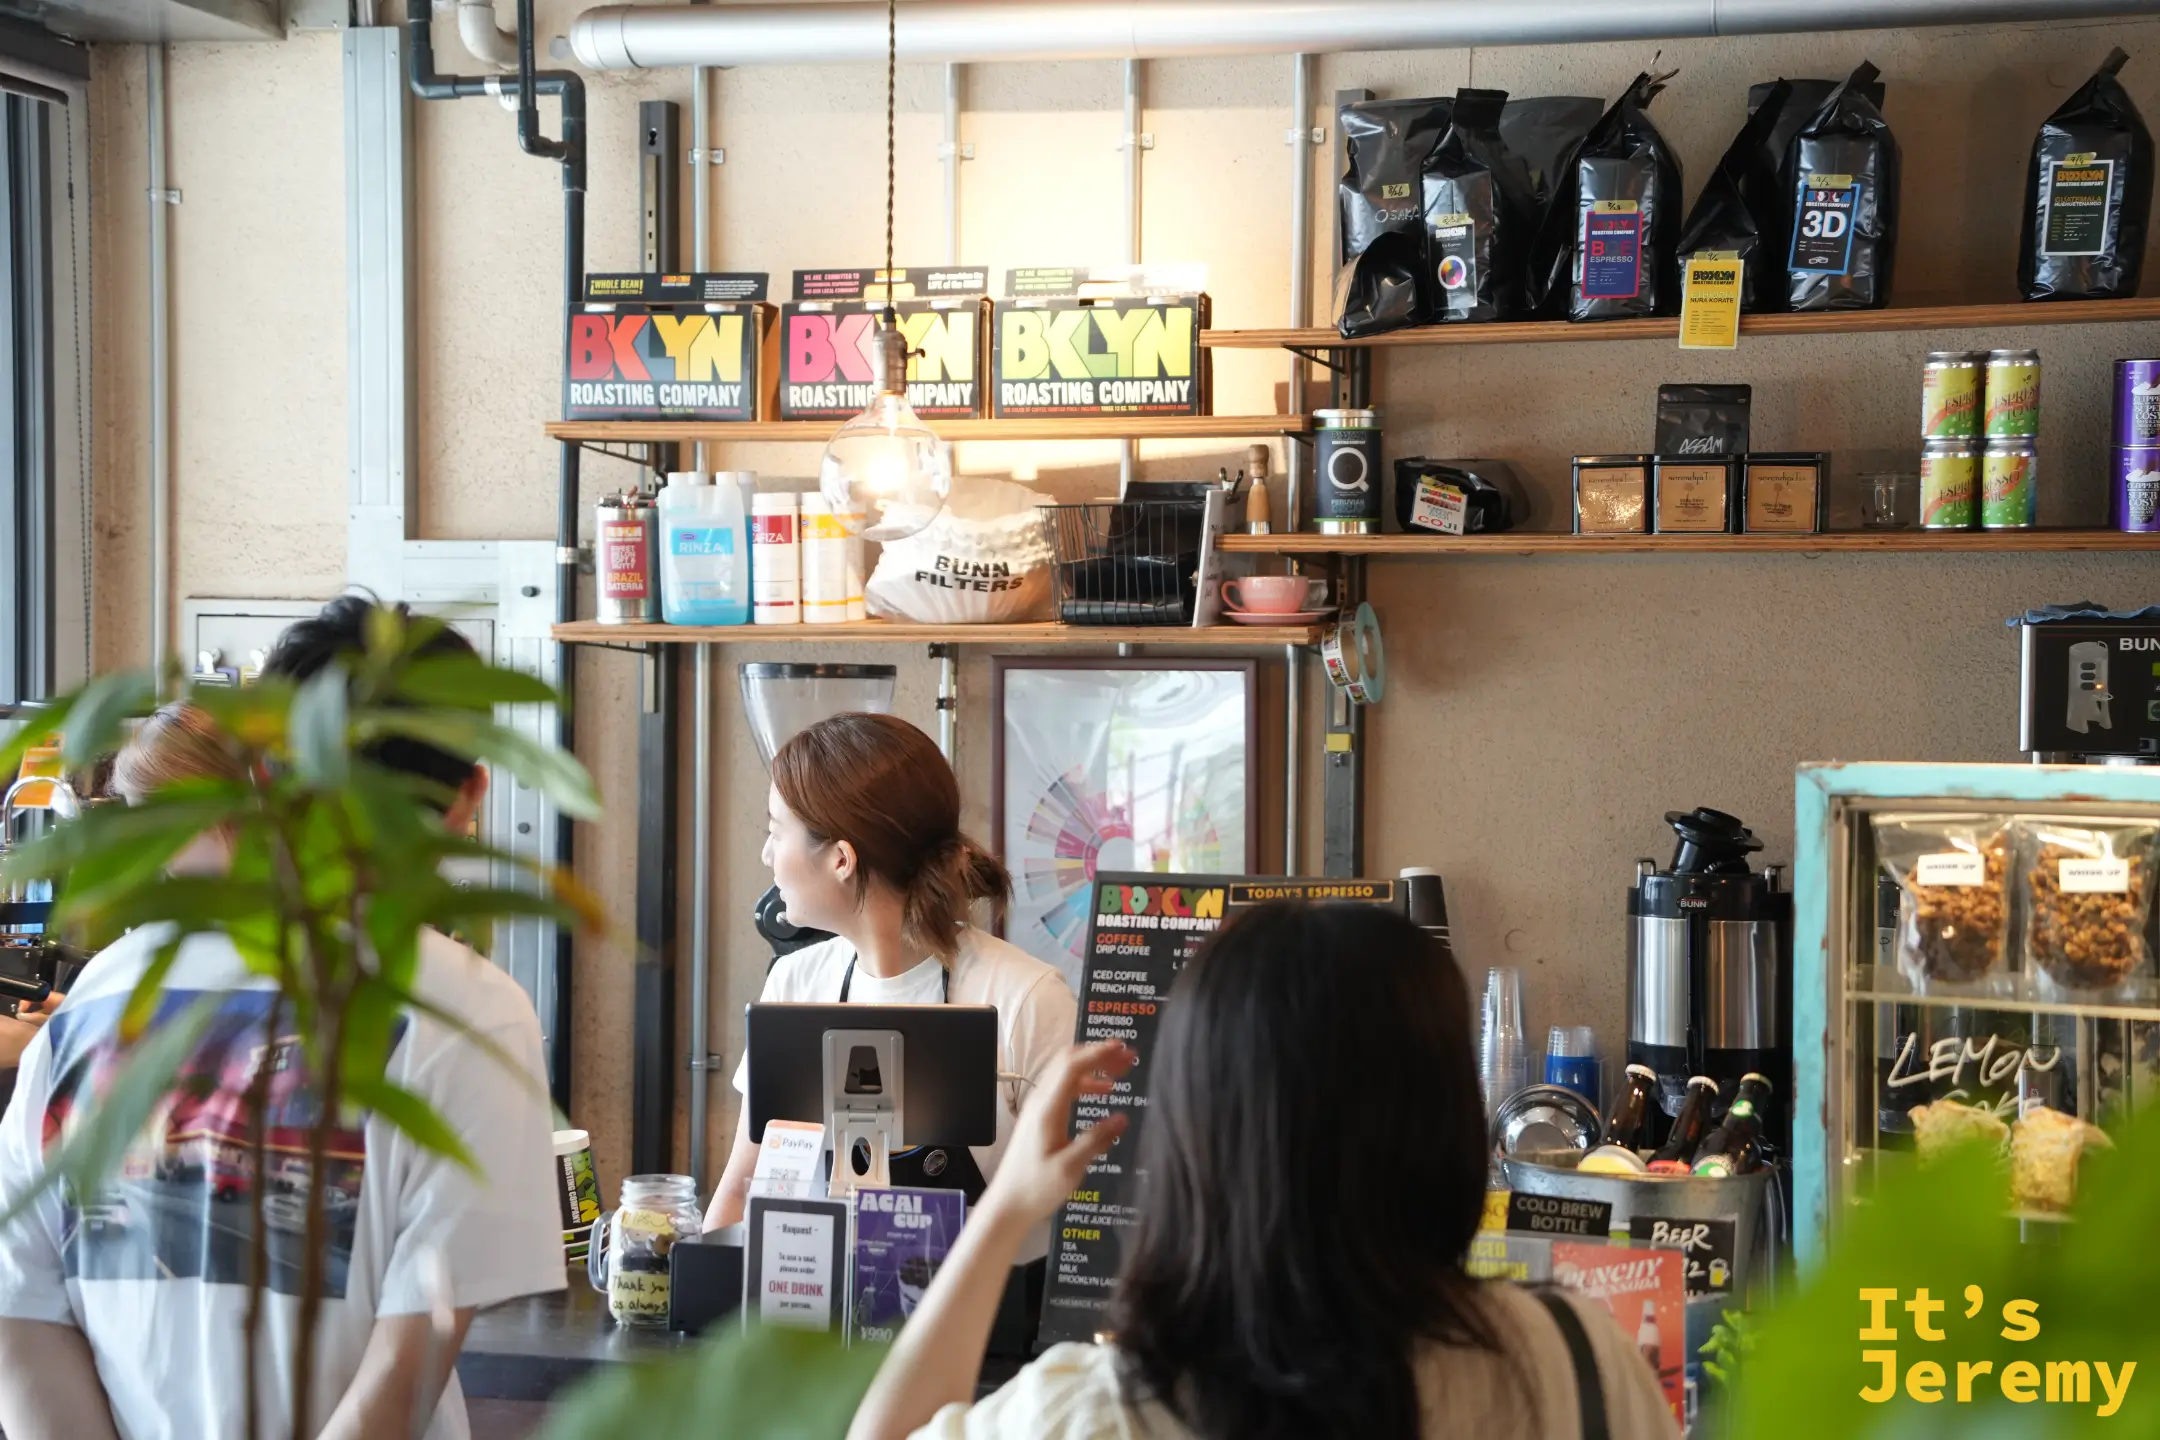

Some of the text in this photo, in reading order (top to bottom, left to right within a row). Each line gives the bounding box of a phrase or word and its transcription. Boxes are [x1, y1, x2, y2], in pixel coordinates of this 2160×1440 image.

[1802, 209, 1848, 238] 3D
[570, 314, 743, 382] BKLYN
[789, 311, 973, 382] BKYN
[1001, 308, 1192, 380] BKLYN
[570, 383, 742, 407] ROASTING COMPANY
[1001, 379, 1191, 406] ROASTING COMPANY
[1678, 435, 1724, 454] ASSAM
[679, 542, 723, 553] RINZA
[934, 554, 1010, 578] BUNN
[607, 572, 643, 582] BRAZIL
[914, 570, 1024, 594] FILTERS
[1247, 886, 1374, 899] TODAY'S ESPRESSO
[1680, 900, 1707, 908] BUNN
[1097, 914, 1159, 930] ROASTING
[1096, 933, 1145, 946] COFFEE
[1096, 944, 1117, 955] DRIP
[1117, 945, 1152, 957] COFFEE
[1173, 948, 1181, 957] M
[1092, 969, 1149, 982] ICED COFFEE
[1091, 982, 1156, 996] FRENCH PRESS
[1087, 1000, 1157, 1016] ESPRESSO
[1087, 1014, 1134, 1027] ESPRESSO
[1086, 1027, 1138, 1040] MACCHIATO
[1887, 1031, 2062, 1088] LEMON
[1079, 1093, 1108, 1105] MAPLE
[1108, 1094, 1133, 1106] SHAY
[1077, 1106, 1110, 1118] MOCHA
[783, 1137, 813, 1150] PayPay
[563, 1157, 581, 1224] ROASTING COMPANY
[859, 1192, 923, 1214] ACAI
[1066, 1202, 1121, 1214] ORANGE JUICE
[1516, 1197, 1603, 1219] COLD BREW
[893, 1213, 933, 1228] CUP
[1065, 1213, 1113, 1226] APPLE JUICE
[1530, 1214, 1590, 1234] BOTTLE
[782, 1223, 812, 1236] Request
[1062, 1227, 1101, 1240] OTHER
[1651, 1220, 1713, 1253] BEER
[1062, 1241, 1077, 1251] TEA
[1060, 1252, 1088, 1263] COCOA
[779, 1264, 816, 1274] please order
[1059, 1263, 1078, 1273] MILK
[612, 1274, 645, 1293] Thank
[1058, 1273, 1100, 1286] BROOKLYN
[768, 1280, 824, 1297] ONE DRINK
[612, 1297, 668, 1313] as always
